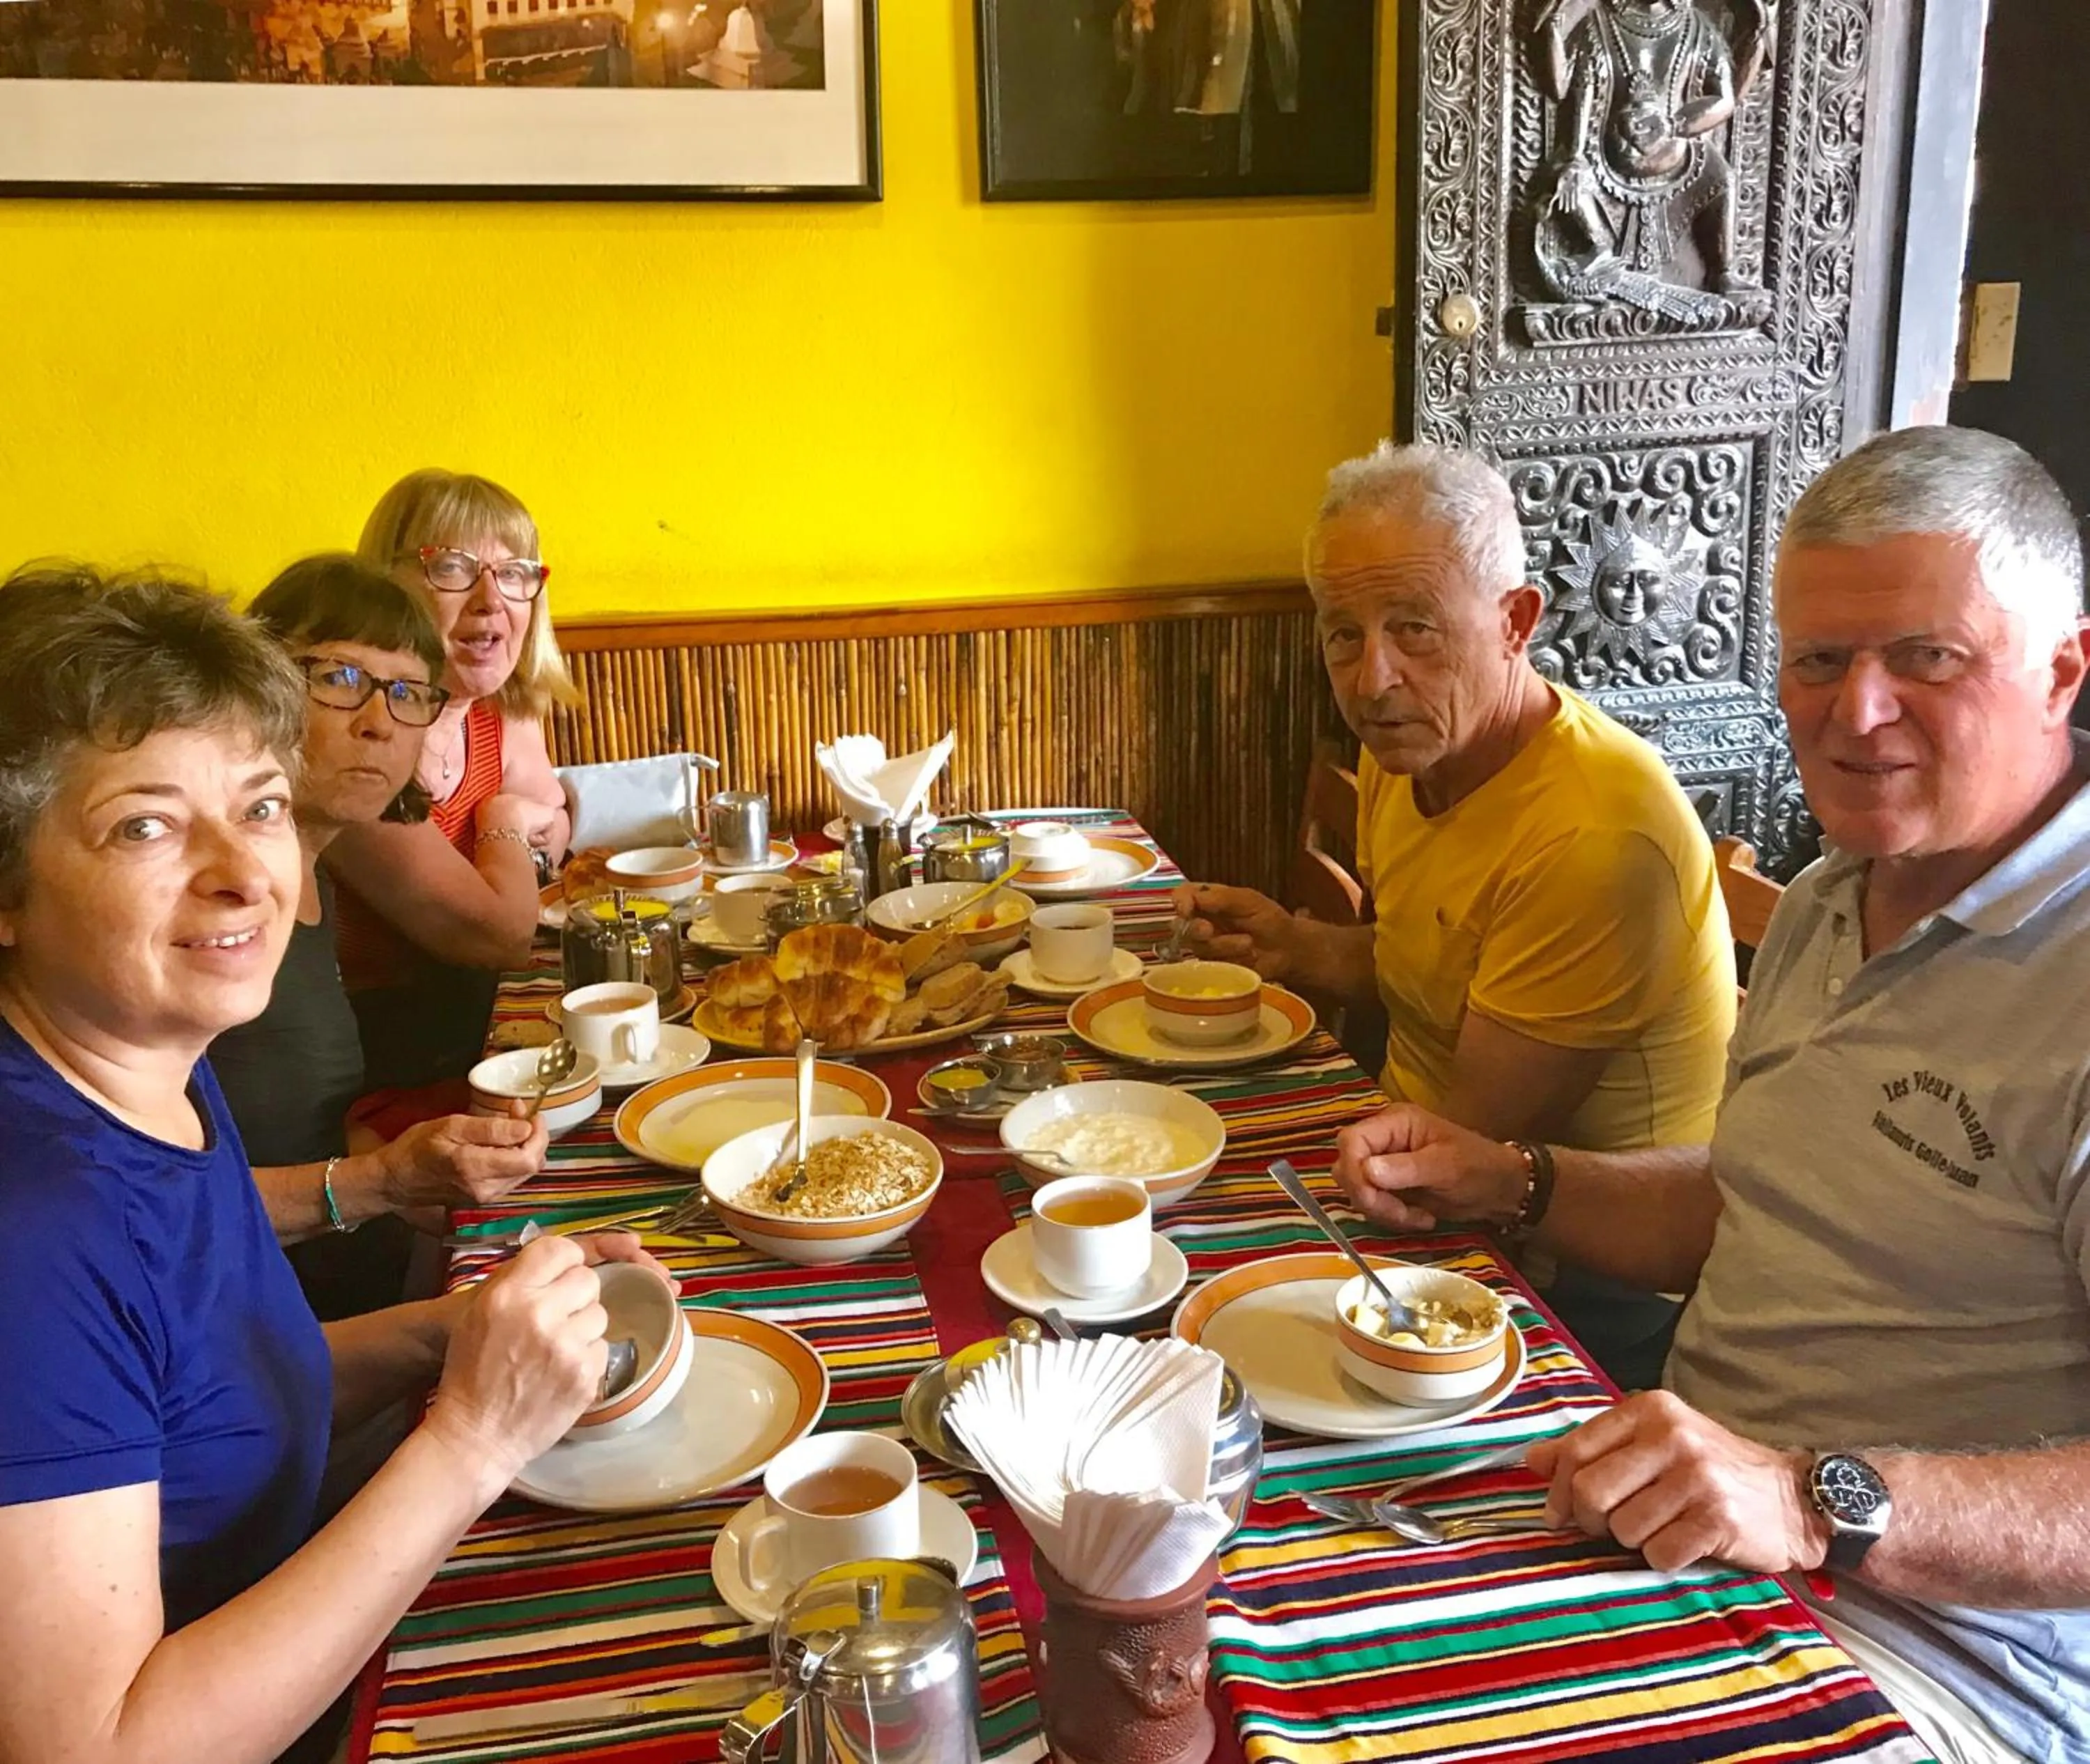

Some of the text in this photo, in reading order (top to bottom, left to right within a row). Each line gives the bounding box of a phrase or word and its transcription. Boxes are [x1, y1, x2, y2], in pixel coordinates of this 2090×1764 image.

[1579, 378, 1680, 415] NIWAS
[1882, 1070, 1996, 1161] Les Vieux Volants
